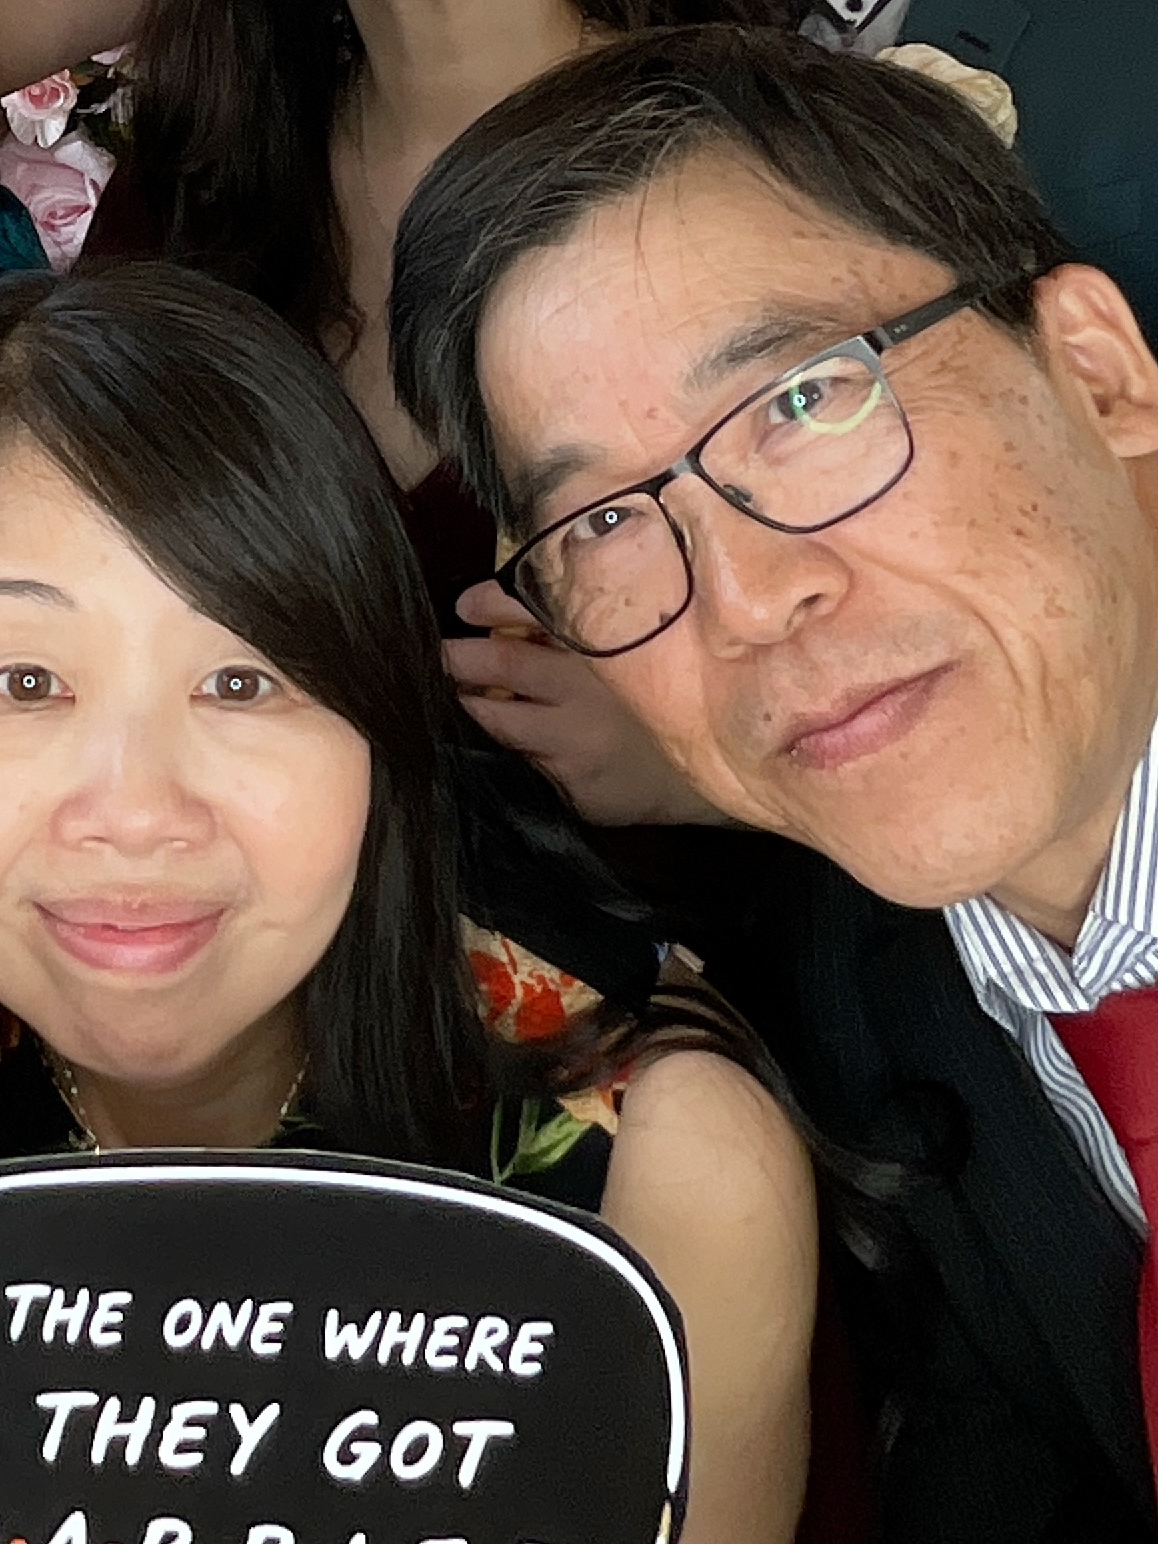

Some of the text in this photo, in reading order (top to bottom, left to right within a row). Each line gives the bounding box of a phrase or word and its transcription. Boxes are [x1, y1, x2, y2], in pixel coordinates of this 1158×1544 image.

[3, 1283, 555, 1377] THE ONE WHERE
[35, 1389, 516, 1490] THEY GOT
